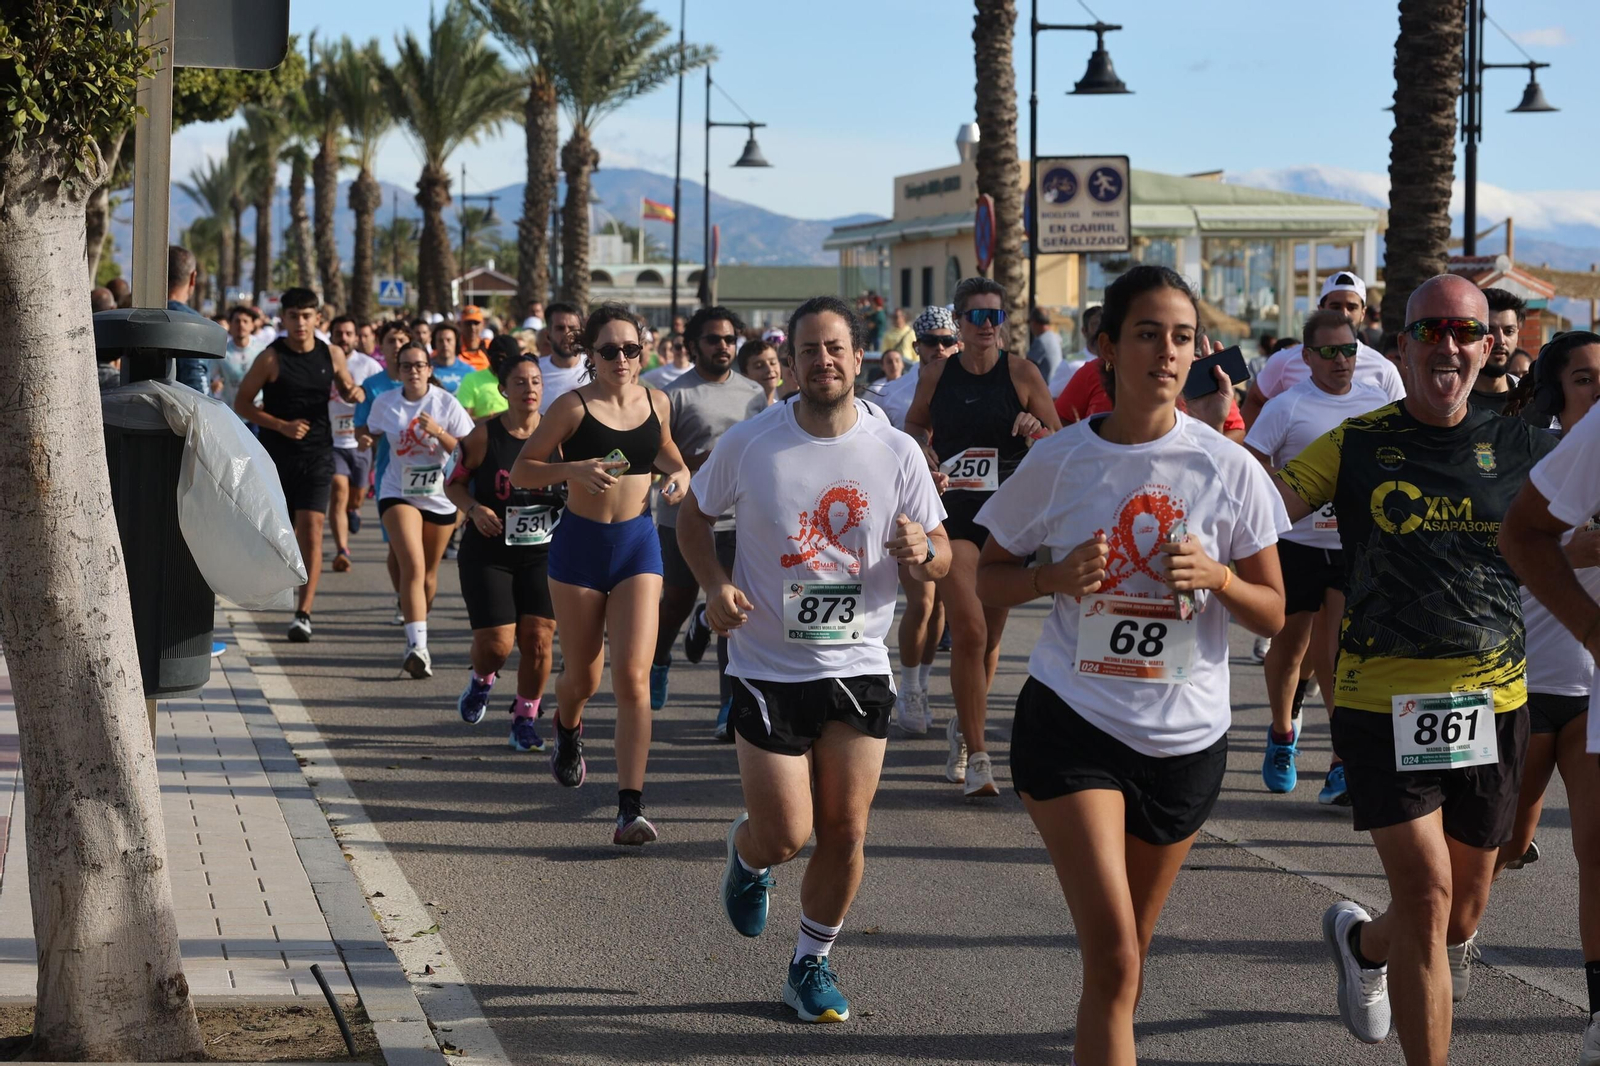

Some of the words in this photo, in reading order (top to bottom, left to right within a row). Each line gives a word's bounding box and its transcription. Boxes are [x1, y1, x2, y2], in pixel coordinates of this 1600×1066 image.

[1049, 224, 1066, 234] EN
[1070, 222, 1118, 233] CARRIL
[1043, 236, 1125, 247] SEÑALIZADO
[949, 458, 991, 478] 250
[410, 472, 437, 486] 714
[515, 514, 546, 533] 531
[797, 596, 857, 624] 873
[1110, 620, 1167, 657] 68
[1081, 663, 1100, 672] 024
[1414, 709, 1478, 745] 861
[1403, 756, 1419, 764] 024
